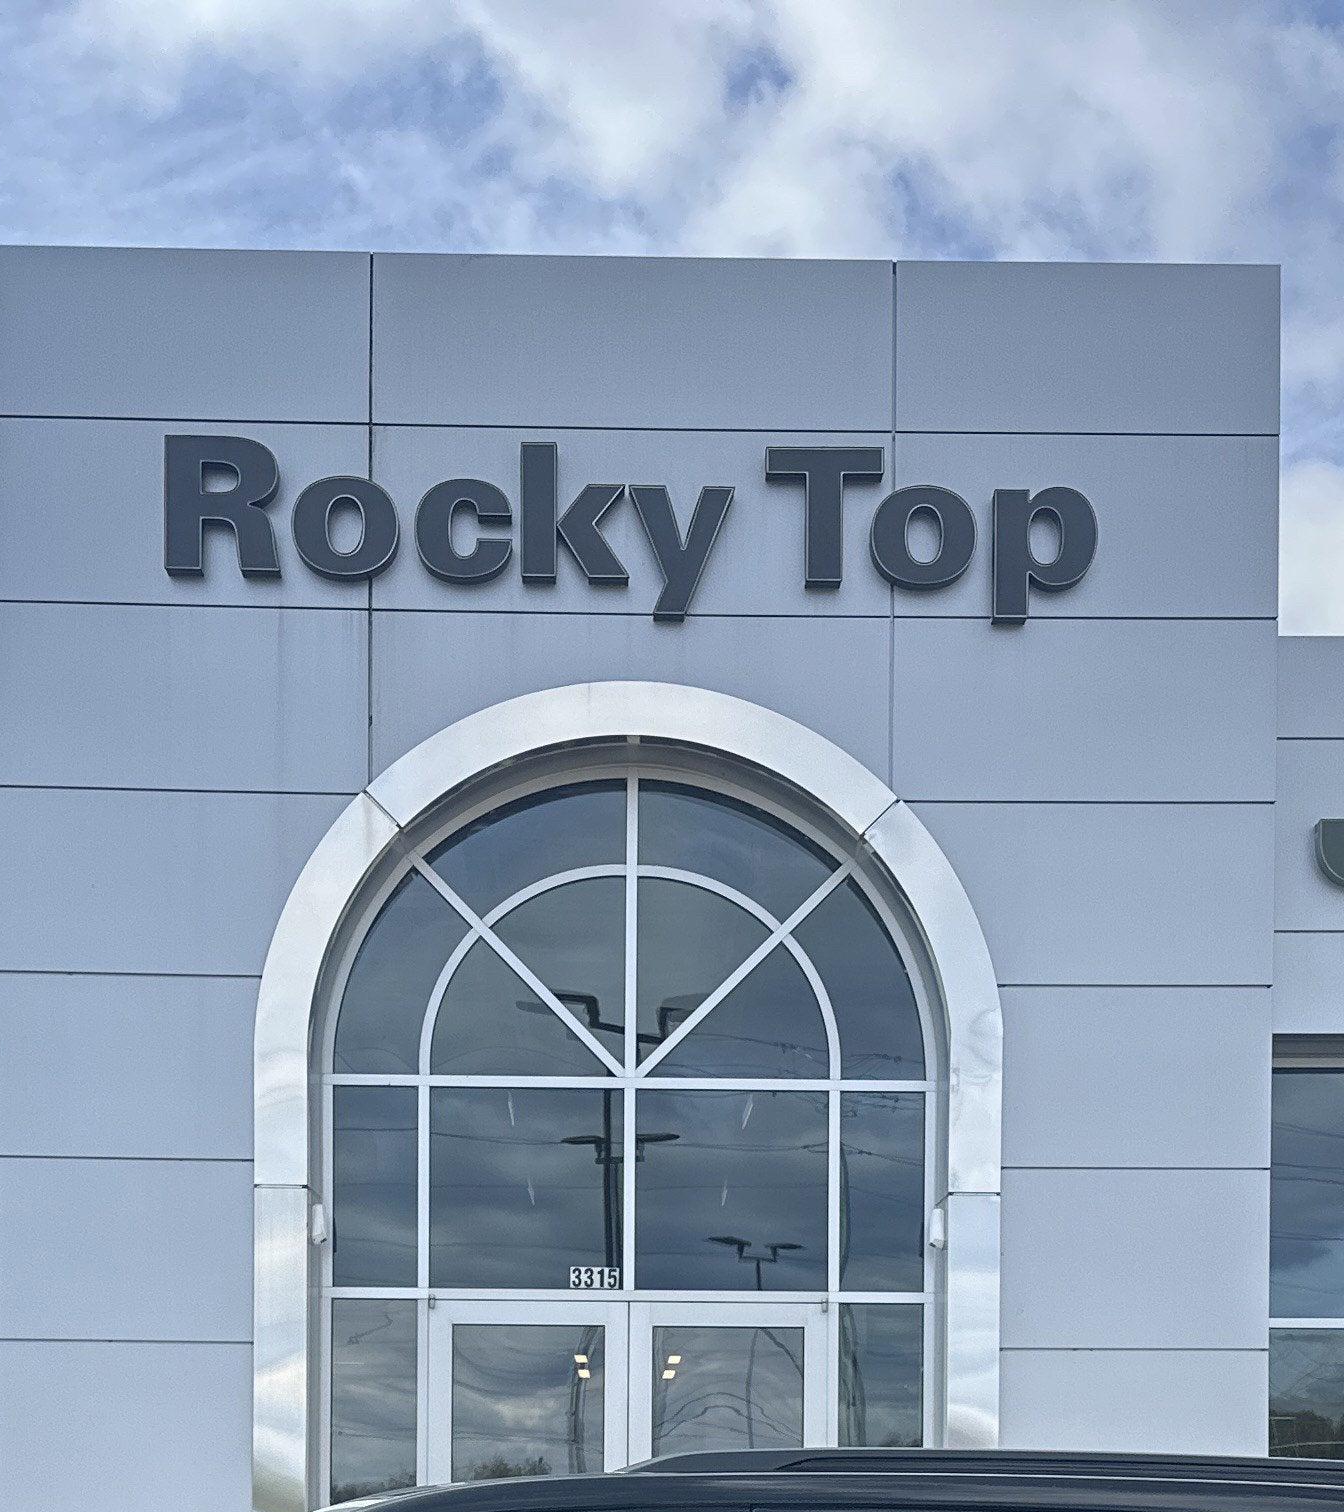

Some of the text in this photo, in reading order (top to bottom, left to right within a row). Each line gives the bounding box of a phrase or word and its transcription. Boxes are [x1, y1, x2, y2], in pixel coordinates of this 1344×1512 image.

[163, 434, 1099, 624] Rocky Top
[571, 1267, 618, 1289] 3315
